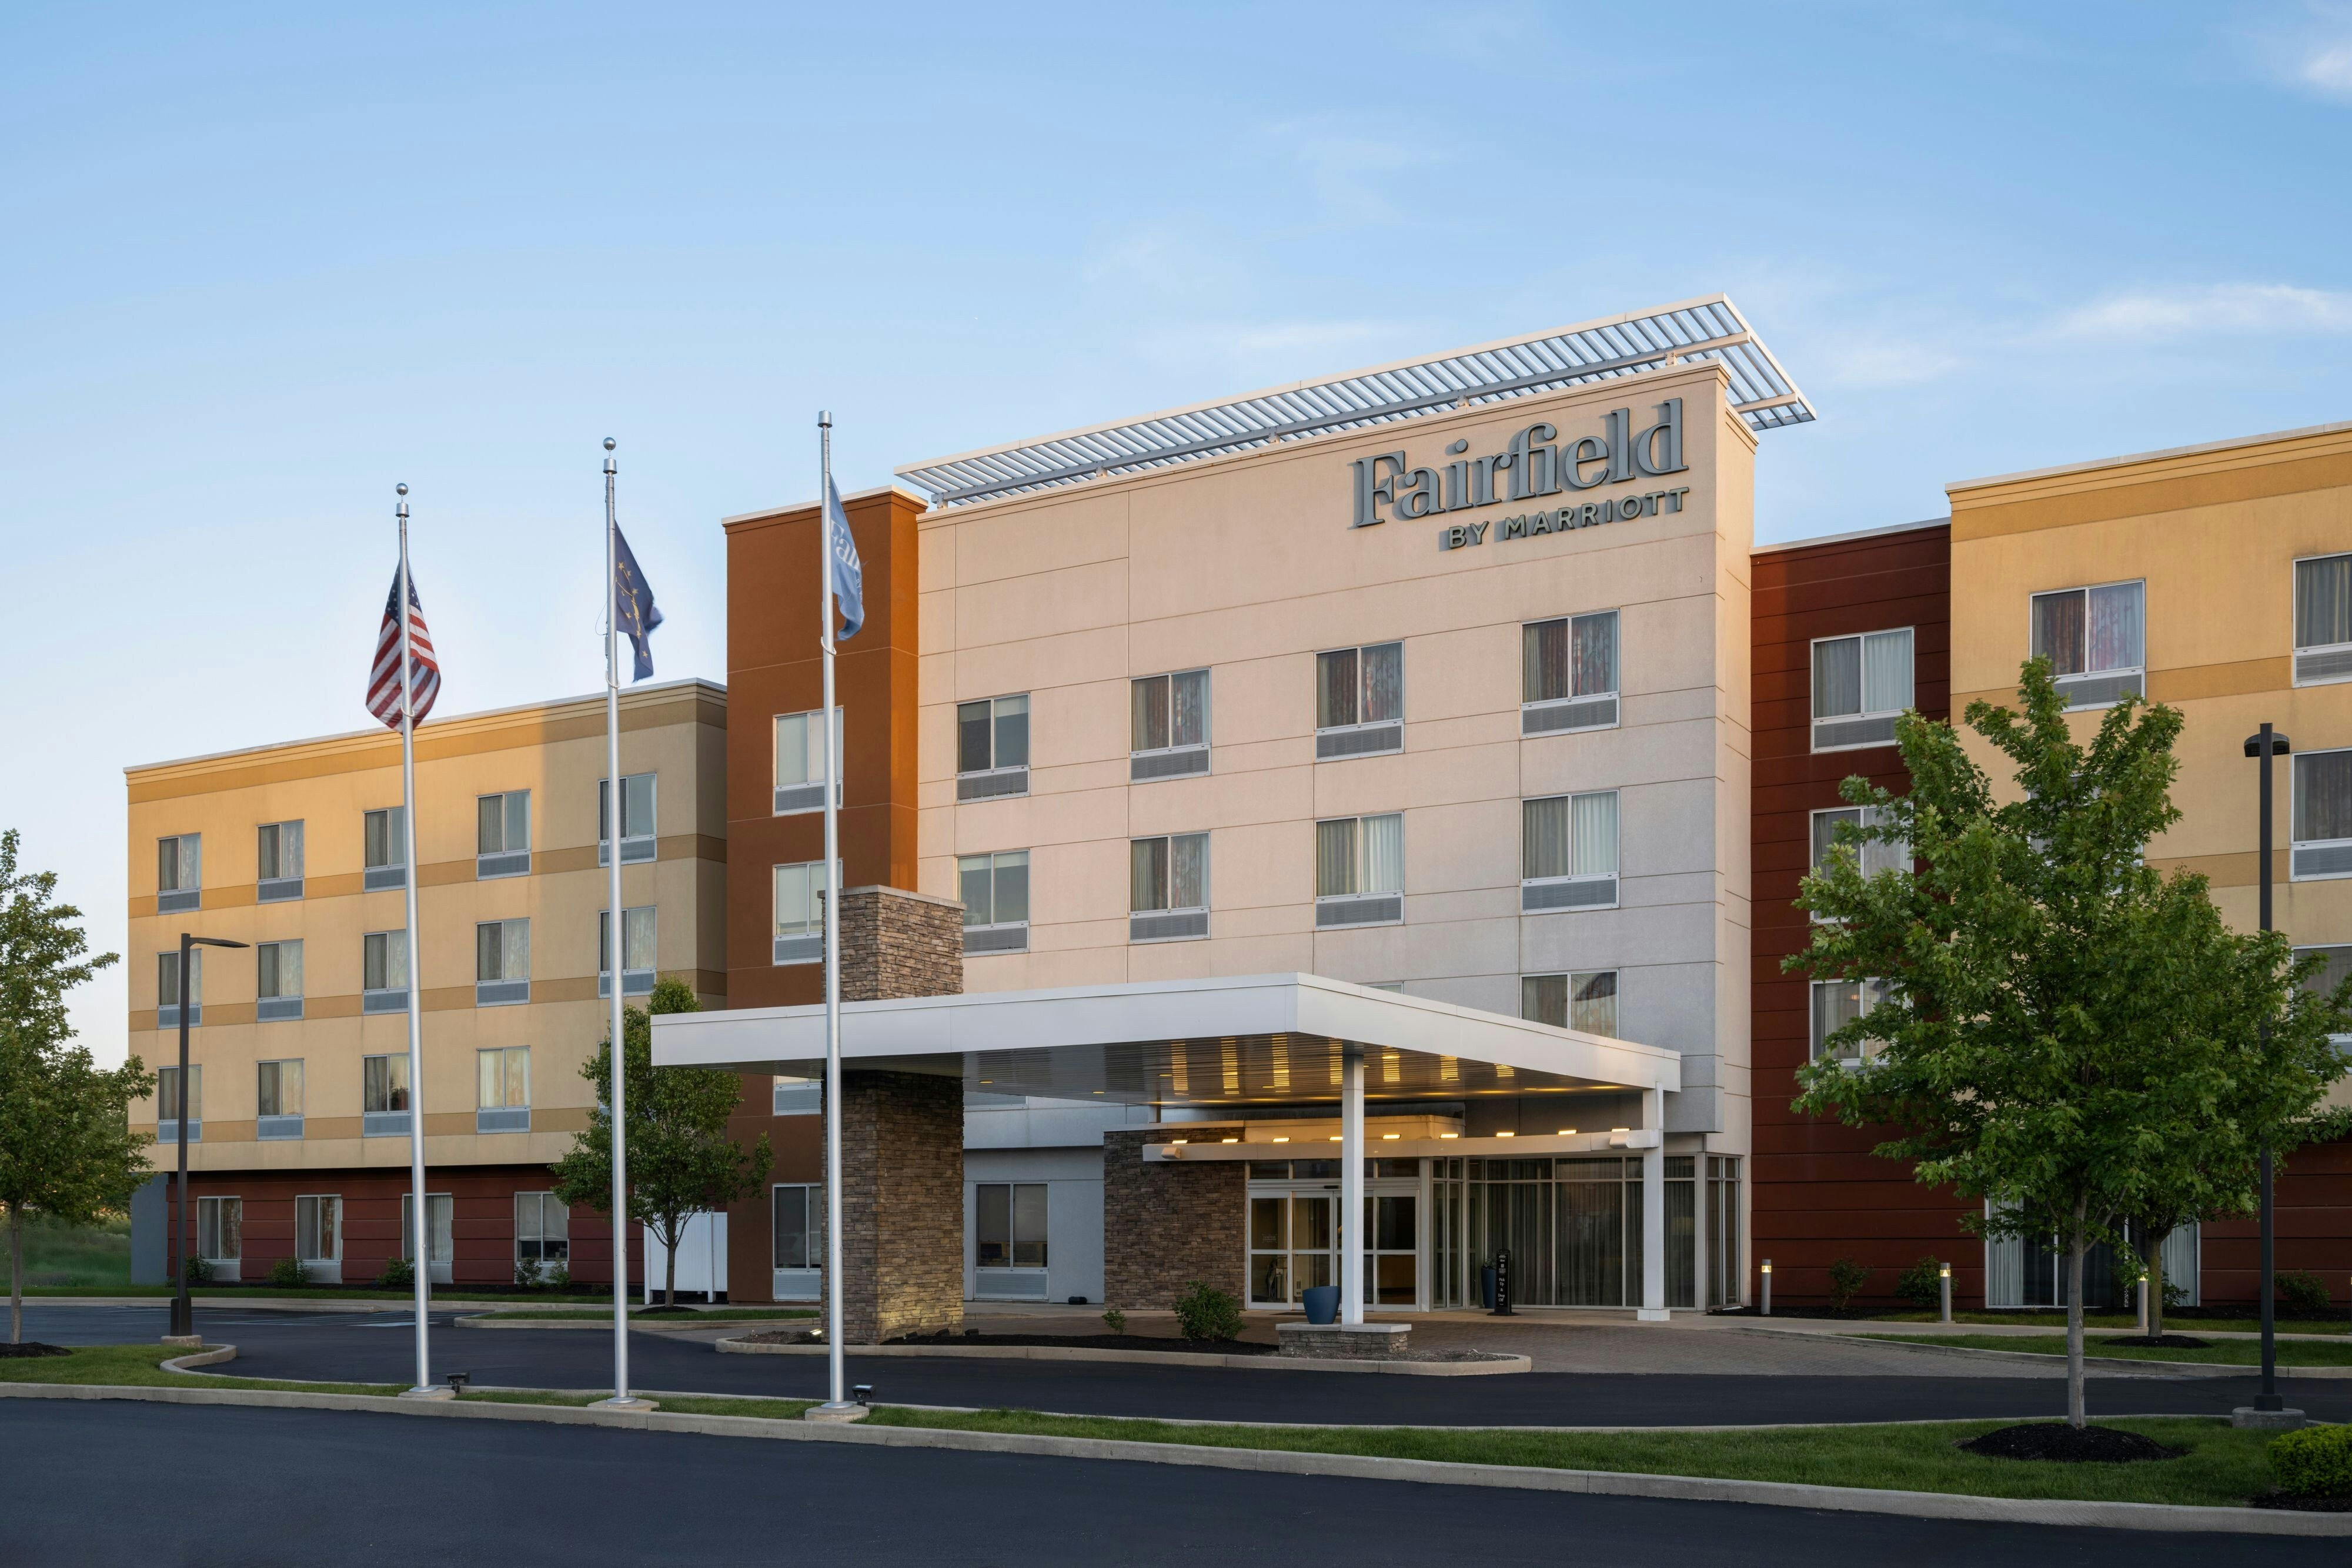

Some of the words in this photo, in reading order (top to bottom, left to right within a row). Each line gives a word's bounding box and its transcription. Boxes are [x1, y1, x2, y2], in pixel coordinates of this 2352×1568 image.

[1356, 397, 1689, 527] Fairfield
[1448, 520, 1489, 549] BY
[1504, 487, 1690, 540] MARRIOTT
